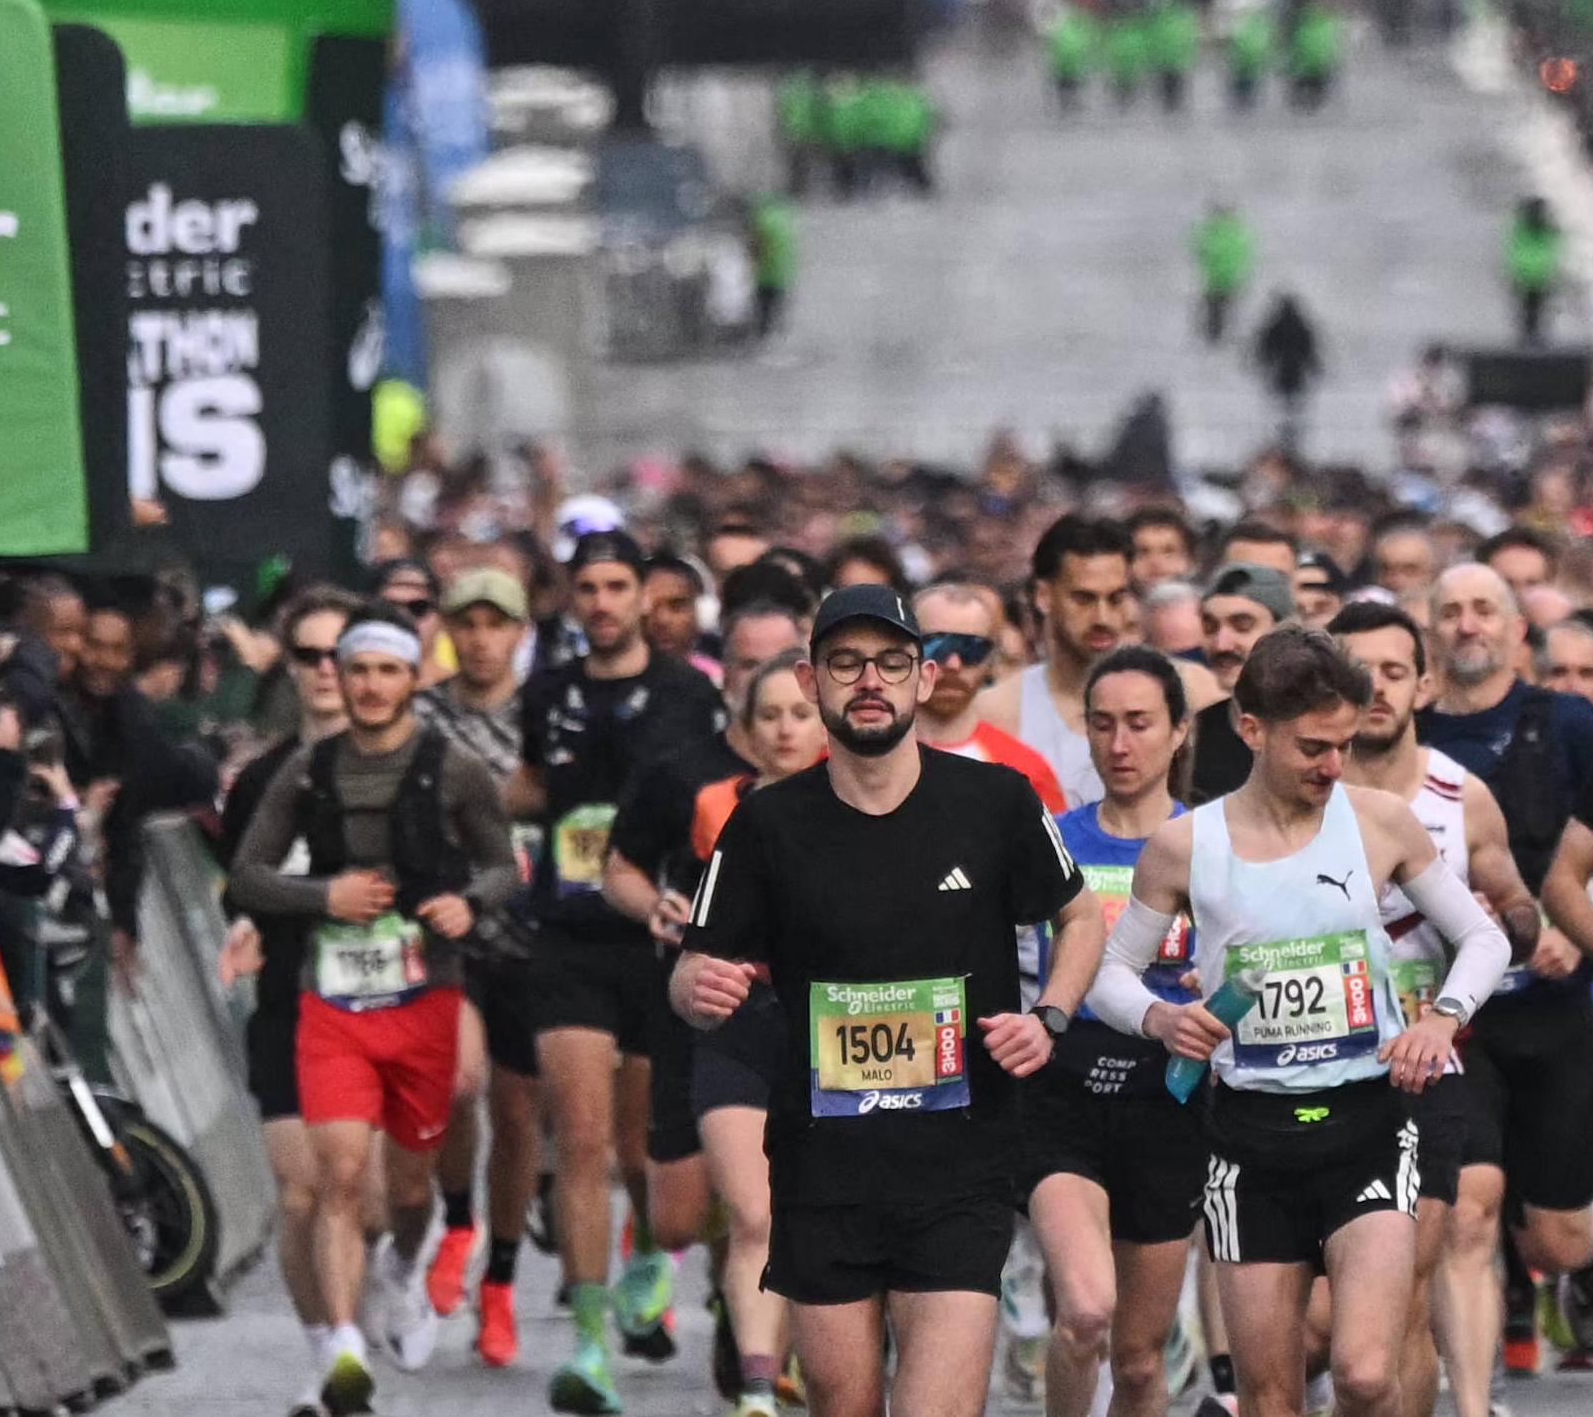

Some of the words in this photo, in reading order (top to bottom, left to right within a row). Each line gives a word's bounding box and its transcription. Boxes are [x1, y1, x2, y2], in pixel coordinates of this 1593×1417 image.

[1239, 940, 1326, 964] Schneider
[827, 985, 916, 1003] Schneider
[1258, 976, 1326, 1020] 1792
[1254, 1025, 1283, 1039] PUMA
[1285, 1021, 1332, 1038] RUNNING
[836, 1023, 915, 1065] 1504
[1297, 1043, 1337, 1061] asics
[1097, 1056, 1136, 1069] COMP
[862, 1069, 892, 1082] MALO
[1090, 1068, 1127, 1082] RESS
[879, 1093, 922, 1108] asics
